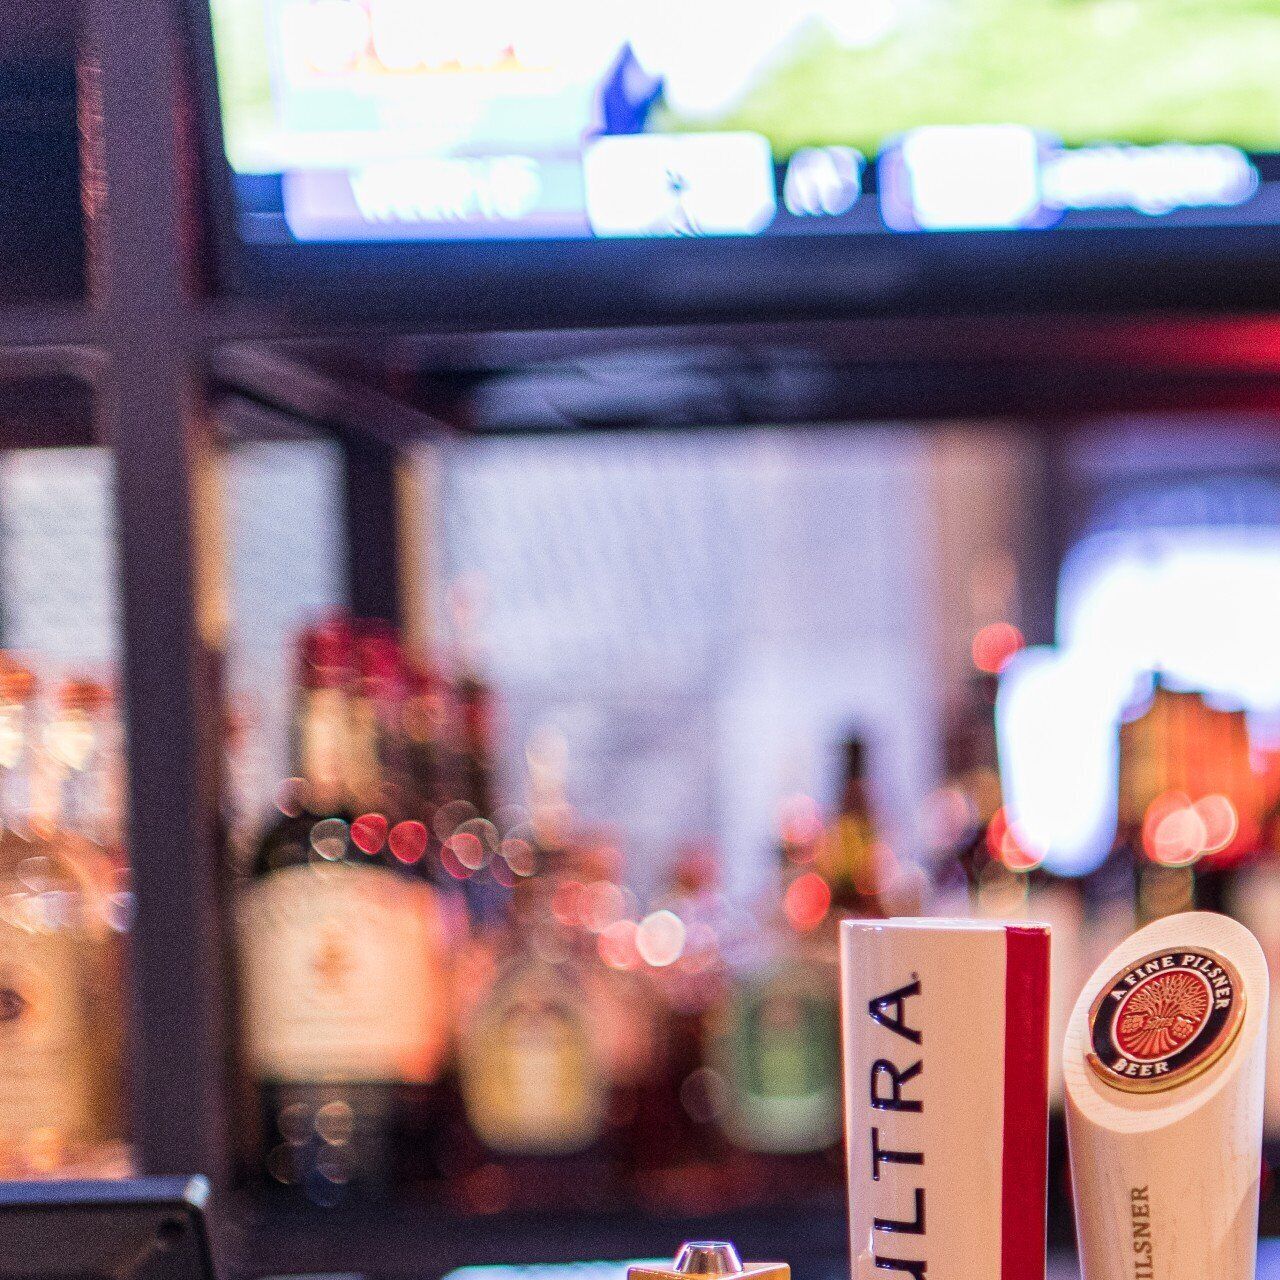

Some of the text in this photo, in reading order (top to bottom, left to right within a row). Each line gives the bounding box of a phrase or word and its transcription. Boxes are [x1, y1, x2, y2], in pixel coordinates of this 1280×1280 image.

[1124, 955, 1175, 986] FINE
[1181, 955, 1231, 1010] PILSNER
[1113, 1058, 1170, 1077] BEER
